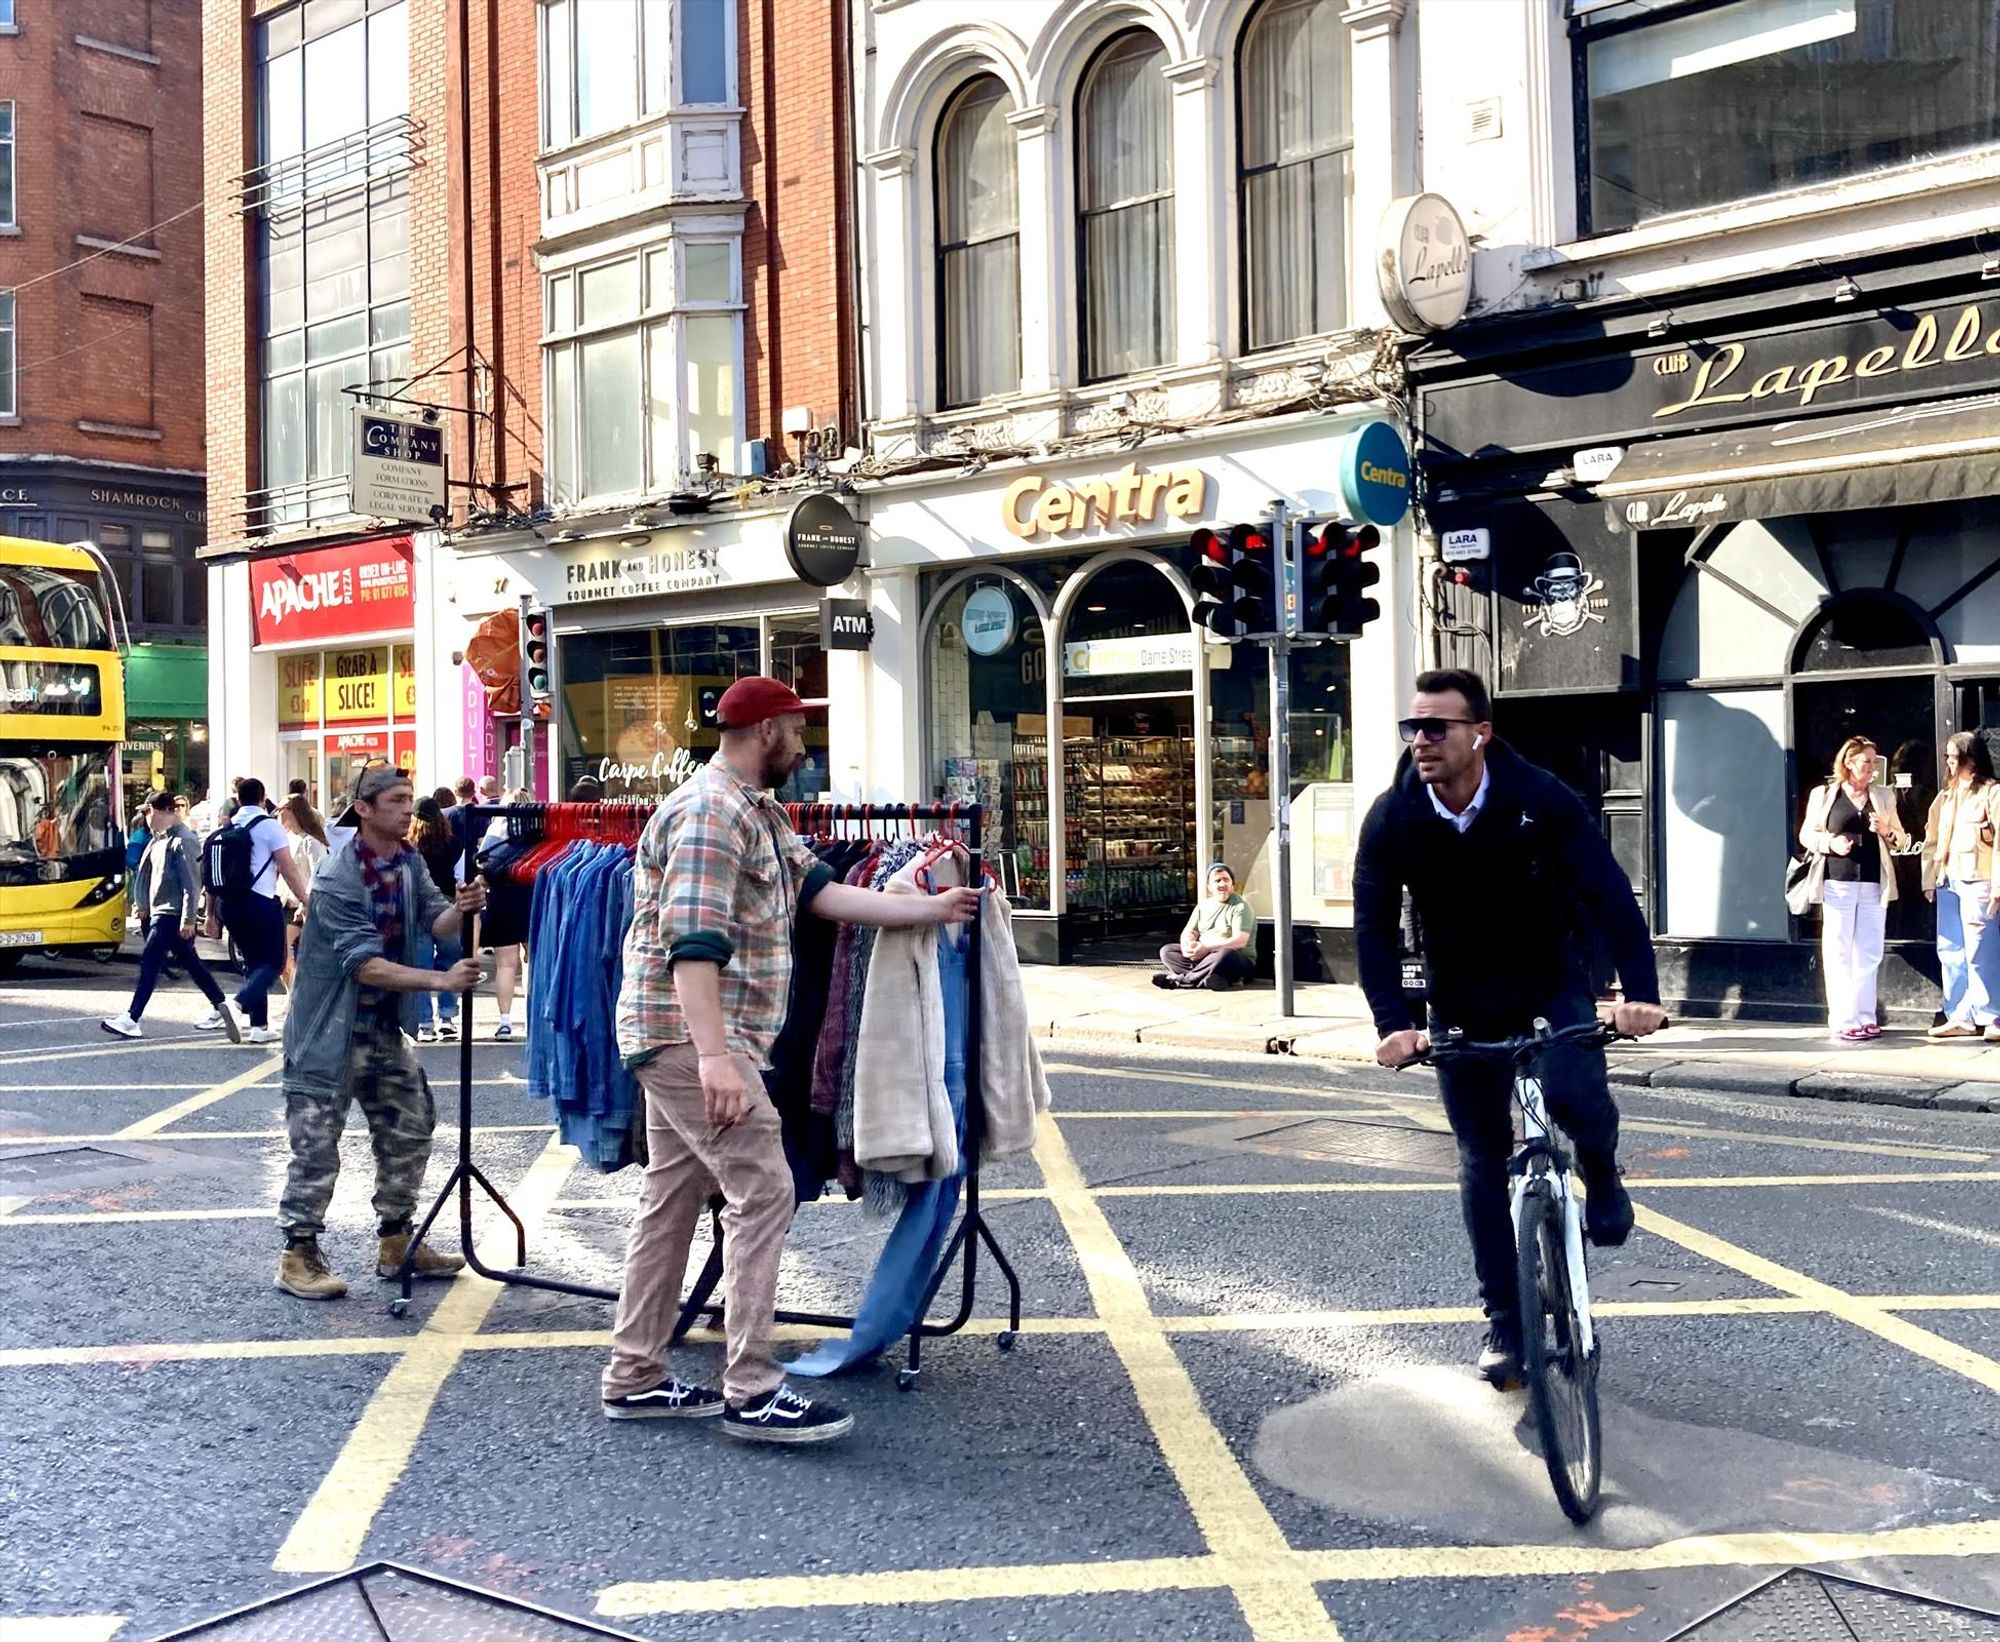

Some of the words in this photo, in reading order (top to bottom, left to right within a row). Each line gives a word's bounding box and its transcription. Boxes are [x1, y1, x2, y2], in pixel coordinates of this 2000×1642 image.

[1653, 354, 1690, 376] CLUB
[389, 424, 416, 437] THE
[384, 447, 421, 460] SHOP
[1583, 453, 1613, 464] LARA
[381, 463, 422, 476] COMPANY
[1361, 460, 1407, 488] Centra
[376, 474, 428, 487] FORMATIONS
[91, 489, 180, 510] SHAMROCK
[369, 501, 395, 511] LEGAL
[1003, 462, 1206, 538] Centra
[797, 533, 821, 542] FRANK
[830, 535, 855, 545] HONEST
[1449, 534, 1477, 544] LARA
[566, 559, 622, 584] FRANK
[627, 562, 644, 572] AND
[649, 548, 719, 574] HONEST
[342, 567, 354, 605] PIZZA
[567, 586, 615, 602] GOURMET
[621, 581, 661, 595] COFFEE
[667, 574, 720, 591] COMPANY
[260, 569, 343, 625] APACHE
[833, 615, 867, 634] ATM
[337, 654, 366, 678] GRAB
[370, 653, 377, 675] A
[1141, 650, 1167, 666] Dame
[1169, 648, 1192, 664] Stree
[338, 682, 375, 711] SLICE!
[468, 671, 477, 770] ADULT
[599, 757, 648, 788] Carpe
